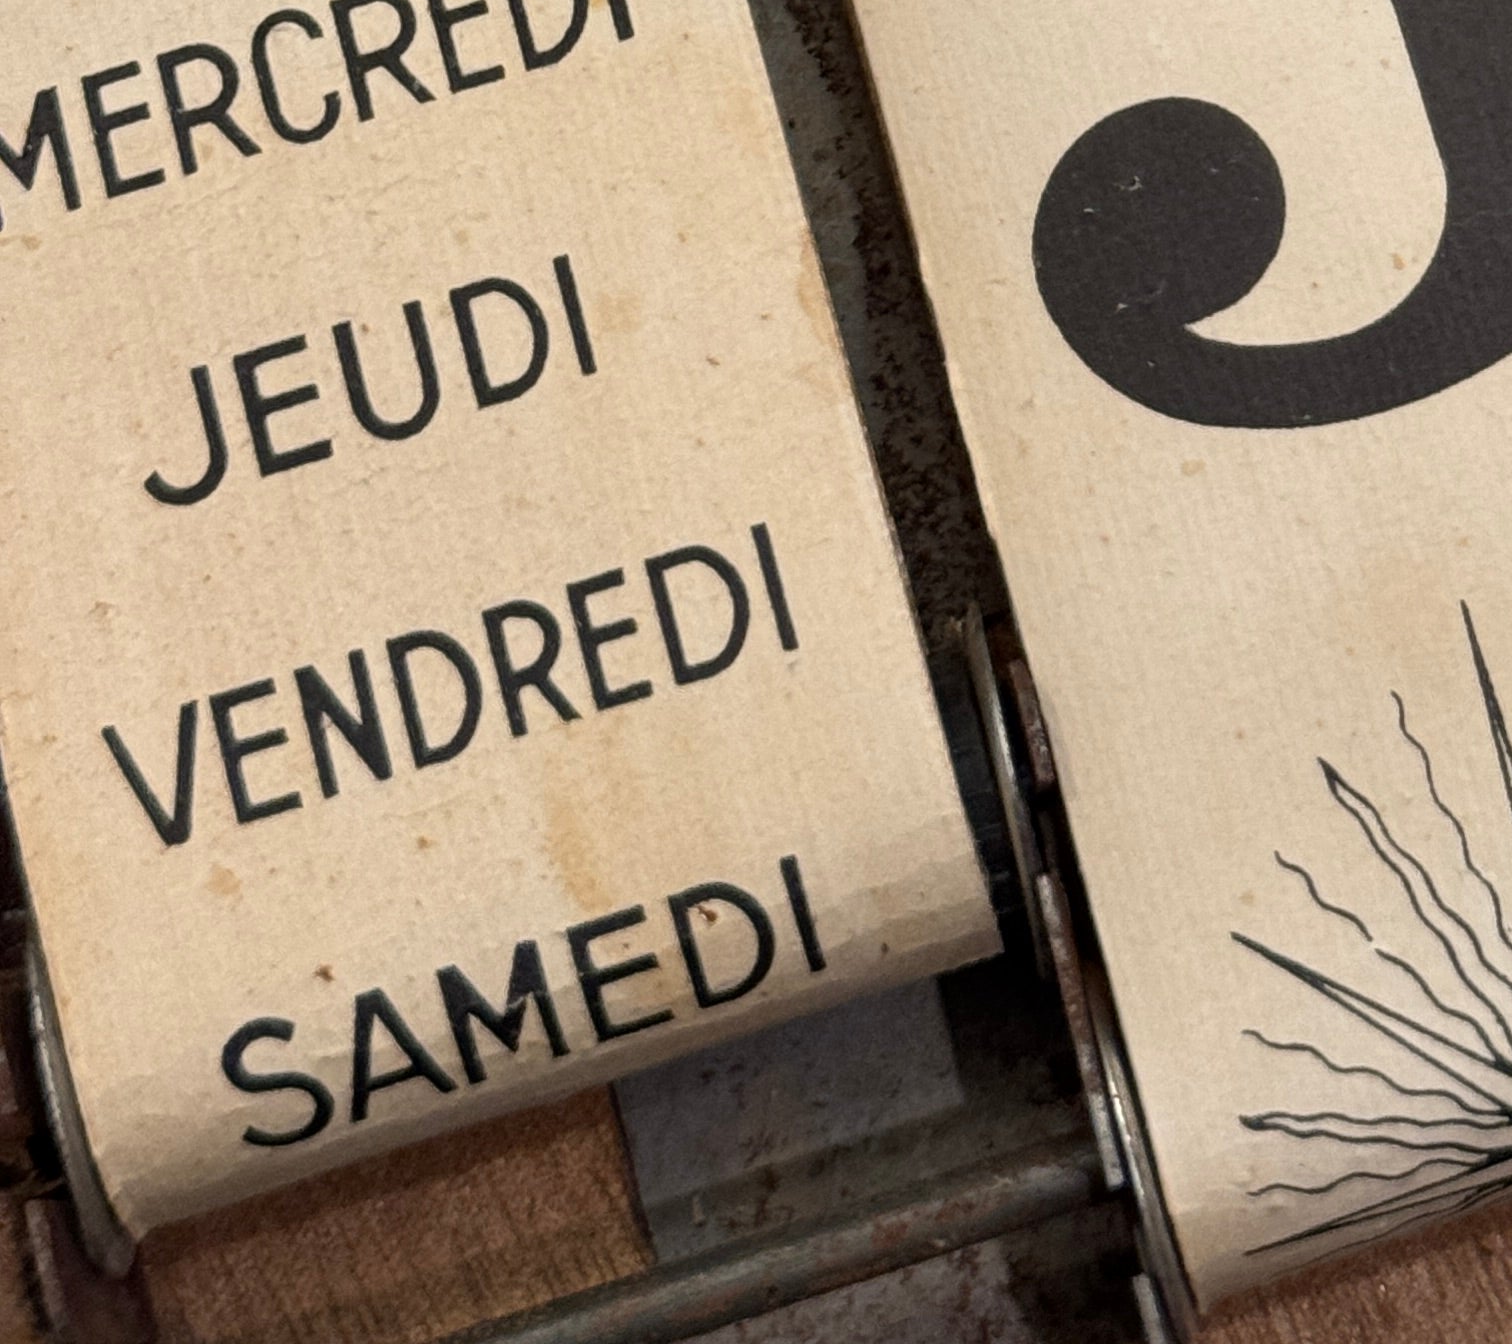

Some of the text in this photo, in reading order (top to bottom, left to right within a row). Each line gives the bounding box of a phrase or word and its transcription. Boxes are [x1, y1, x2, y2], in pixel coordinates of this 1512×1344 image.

[142, 253, 599, 507] JEUDI
[100, 521, 801, 849] VENDREDI
[220, 853, 827, 1147] SAMEDI
